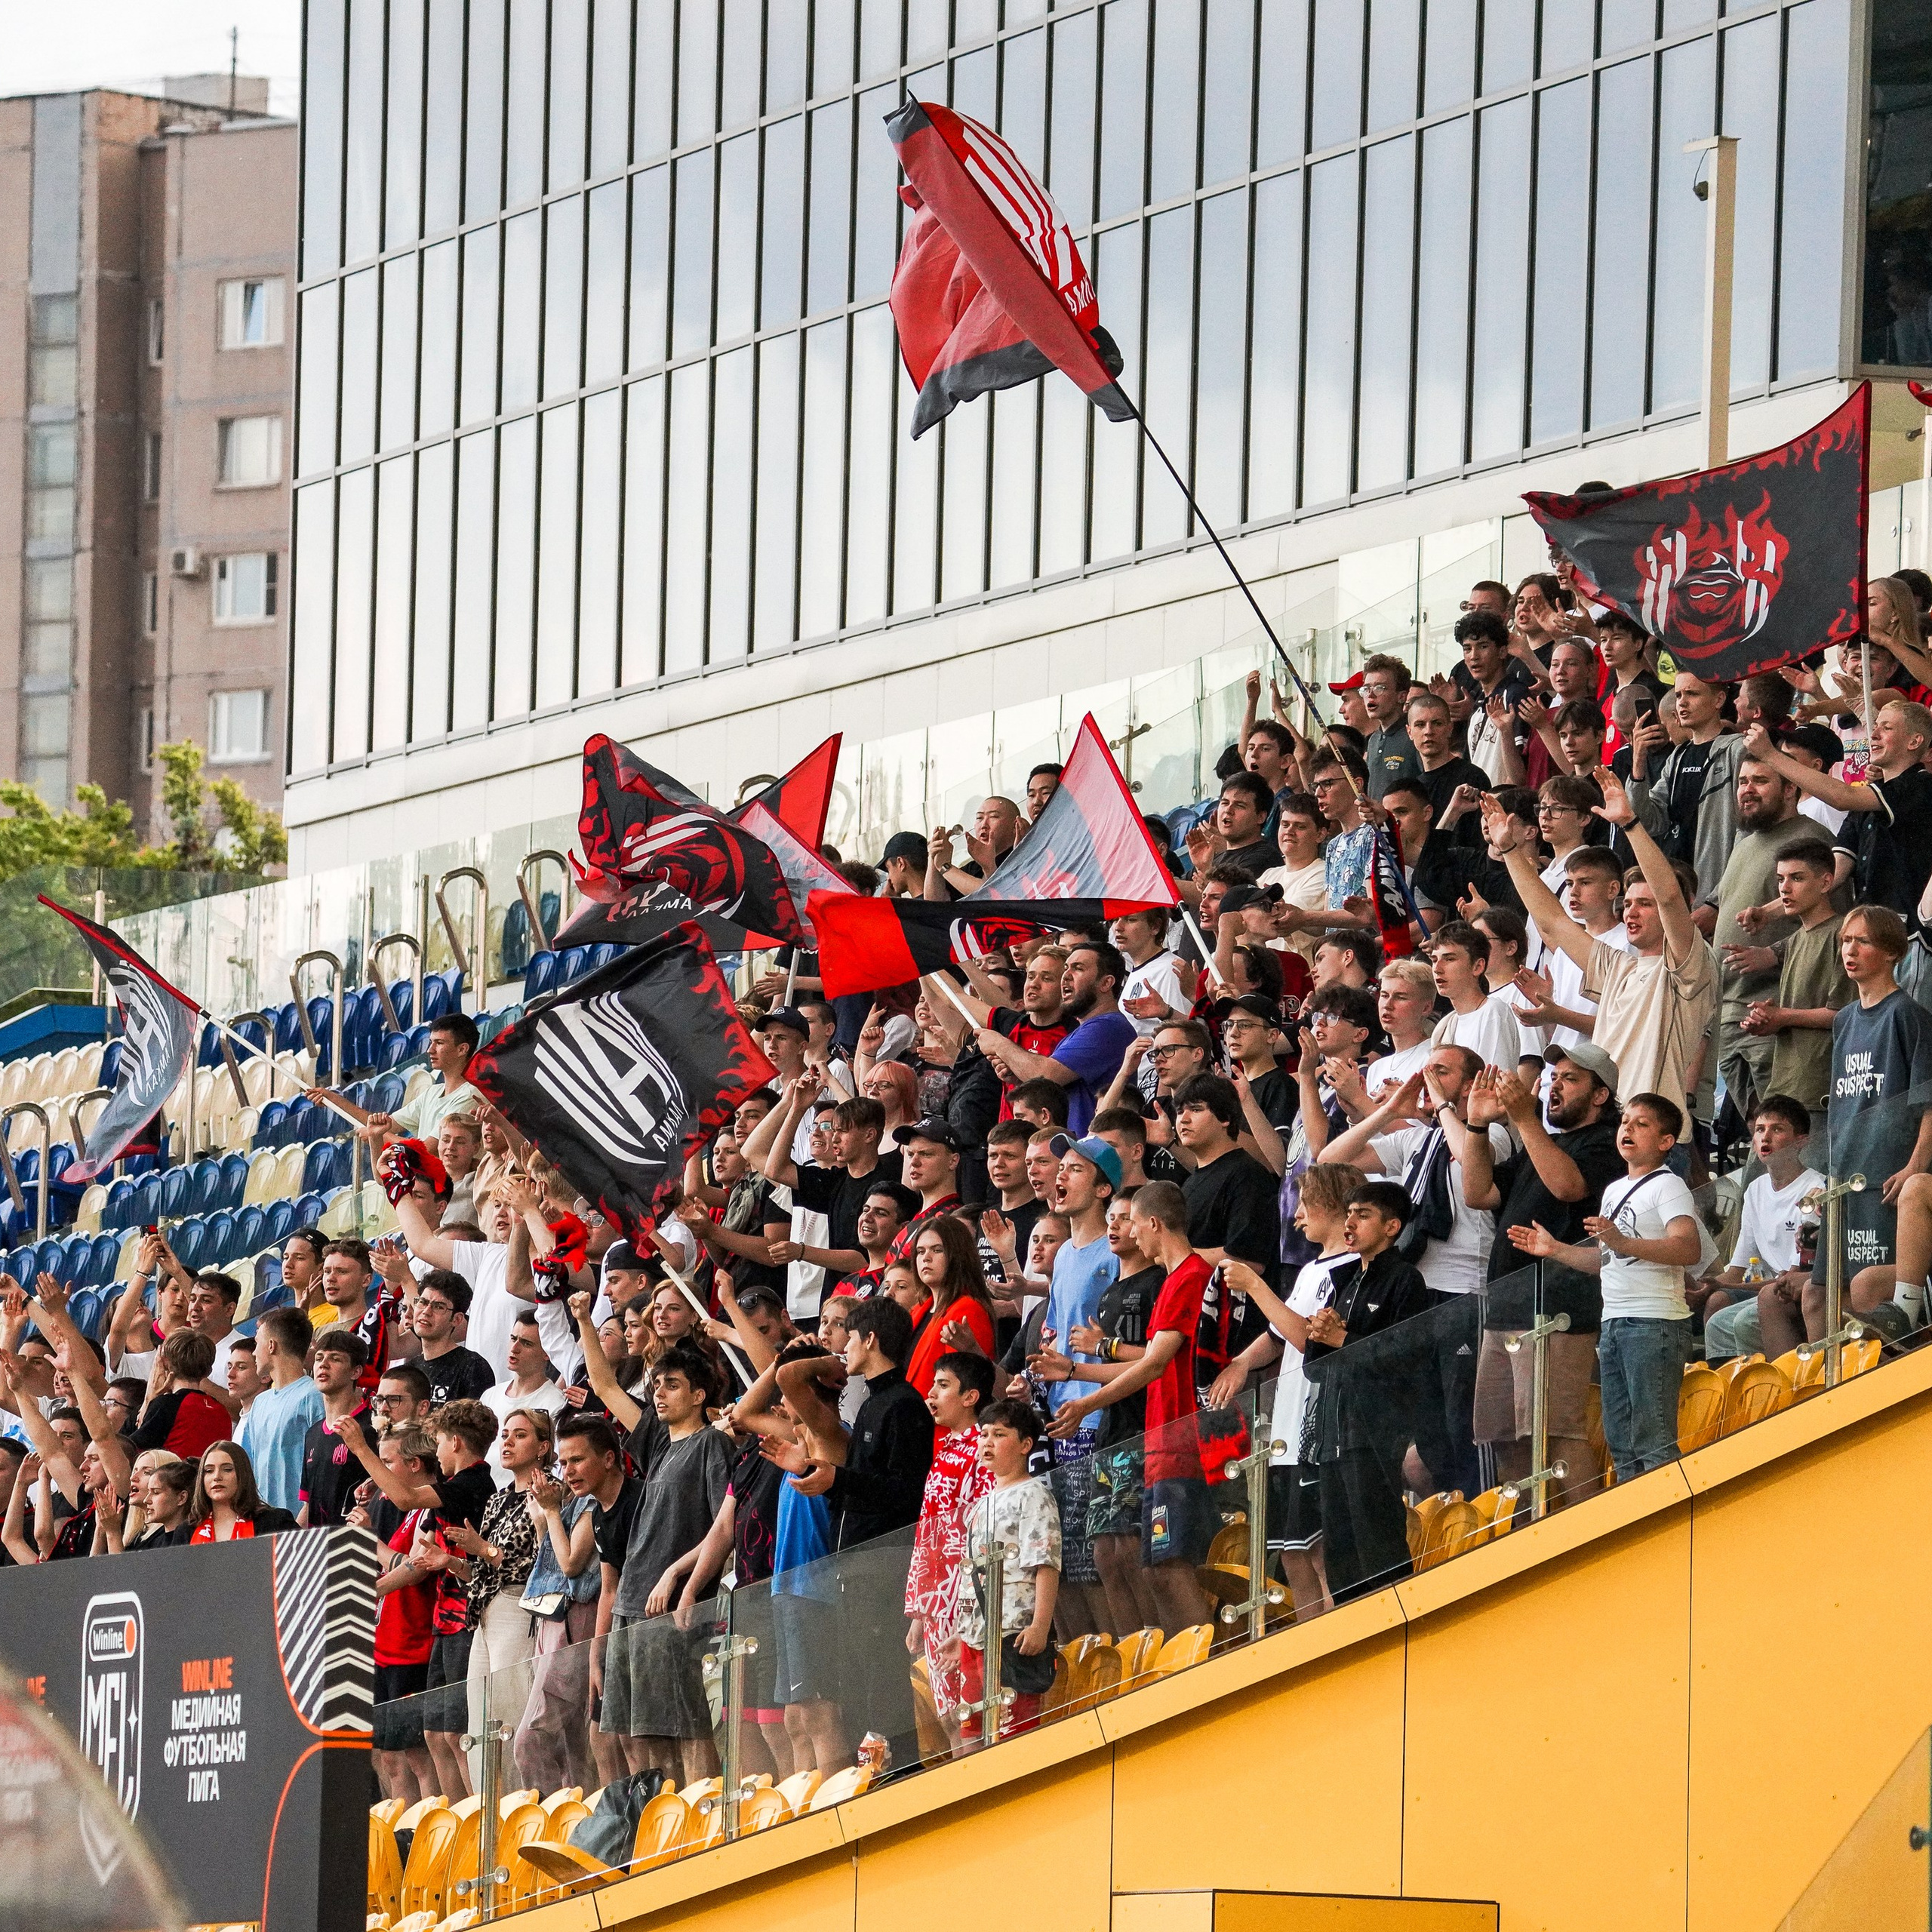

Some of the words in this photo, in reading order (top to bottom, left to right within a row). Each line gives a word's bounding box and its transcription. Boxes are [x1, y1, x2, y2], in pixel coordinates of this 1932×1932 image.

[1845, 1050, 1874, 1076] USUAL
[1835, 1072, 1885, 1099] SUSPECT
[1150, 1158, 1175, 1170] AIR
[1847, 1229, 1879, 1247] USUAL
[1847, 1245, 1889, 1265] USPECT
[93, 1627, 123, 1651] Winline
[171, 1689, 241, 1733] МЕДИЙНАЯ
[163, 1730, 247, 1767] ФУТБОЛЬНАЯ
